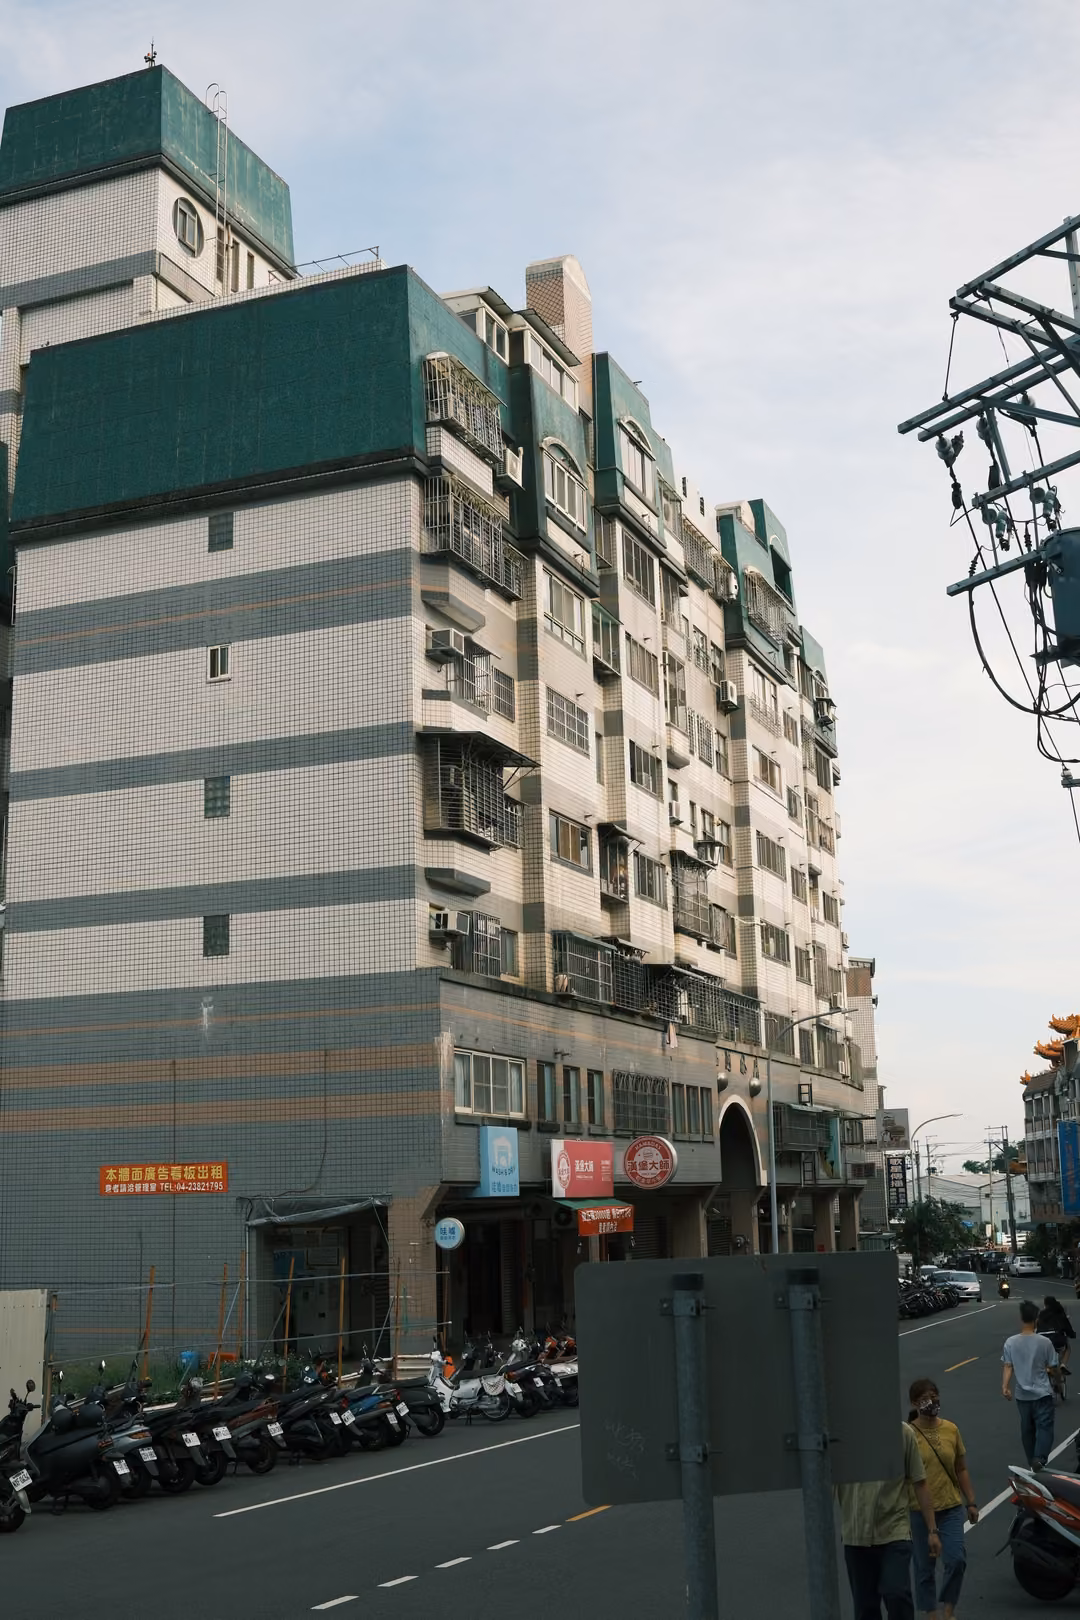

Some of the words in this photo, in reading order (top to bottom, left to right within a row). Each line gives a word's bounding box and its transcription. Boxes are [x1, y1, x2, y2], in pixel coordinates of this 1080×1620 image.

[627, 1158, 670, 1171] 漢堡大師
[105, 1165, 223, 1182] 本牆面廣告看板出租
